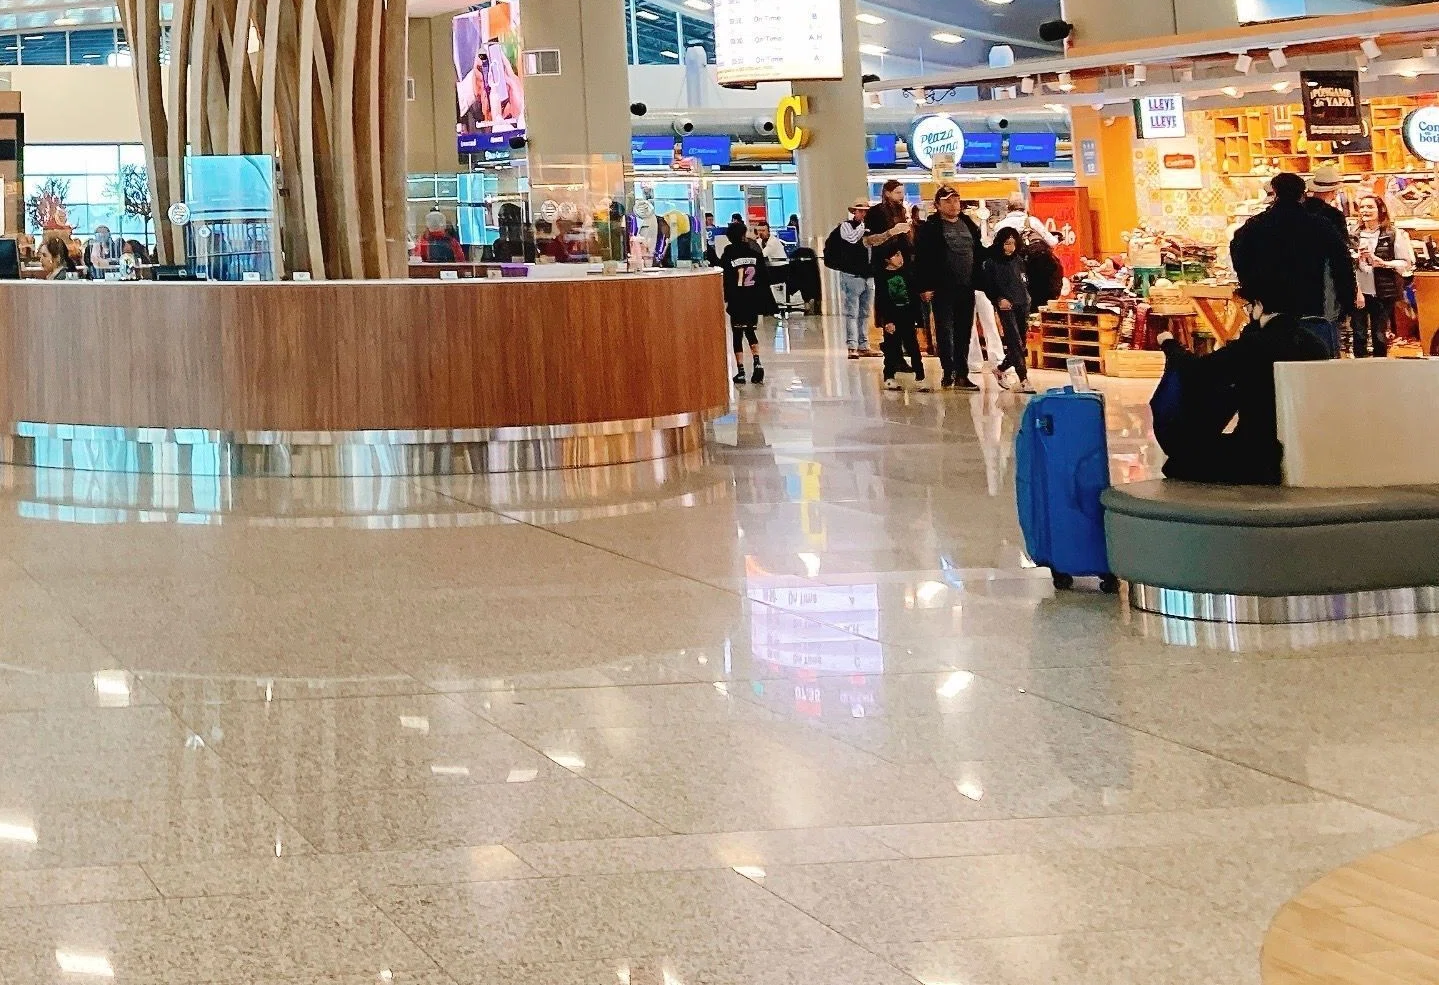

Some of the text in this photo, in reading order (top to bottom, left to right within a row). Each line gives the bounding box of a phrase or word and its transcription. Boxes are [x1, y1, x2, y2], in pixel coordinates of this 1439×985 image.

[1148, 98, 1176, 112] LLEVE
[776, 95, 809, 151] C
[1150, 115, 1178, 129] LLEVE
[921, 128, 954, 145] Plaza
[737, 266, 756, 287] 12
